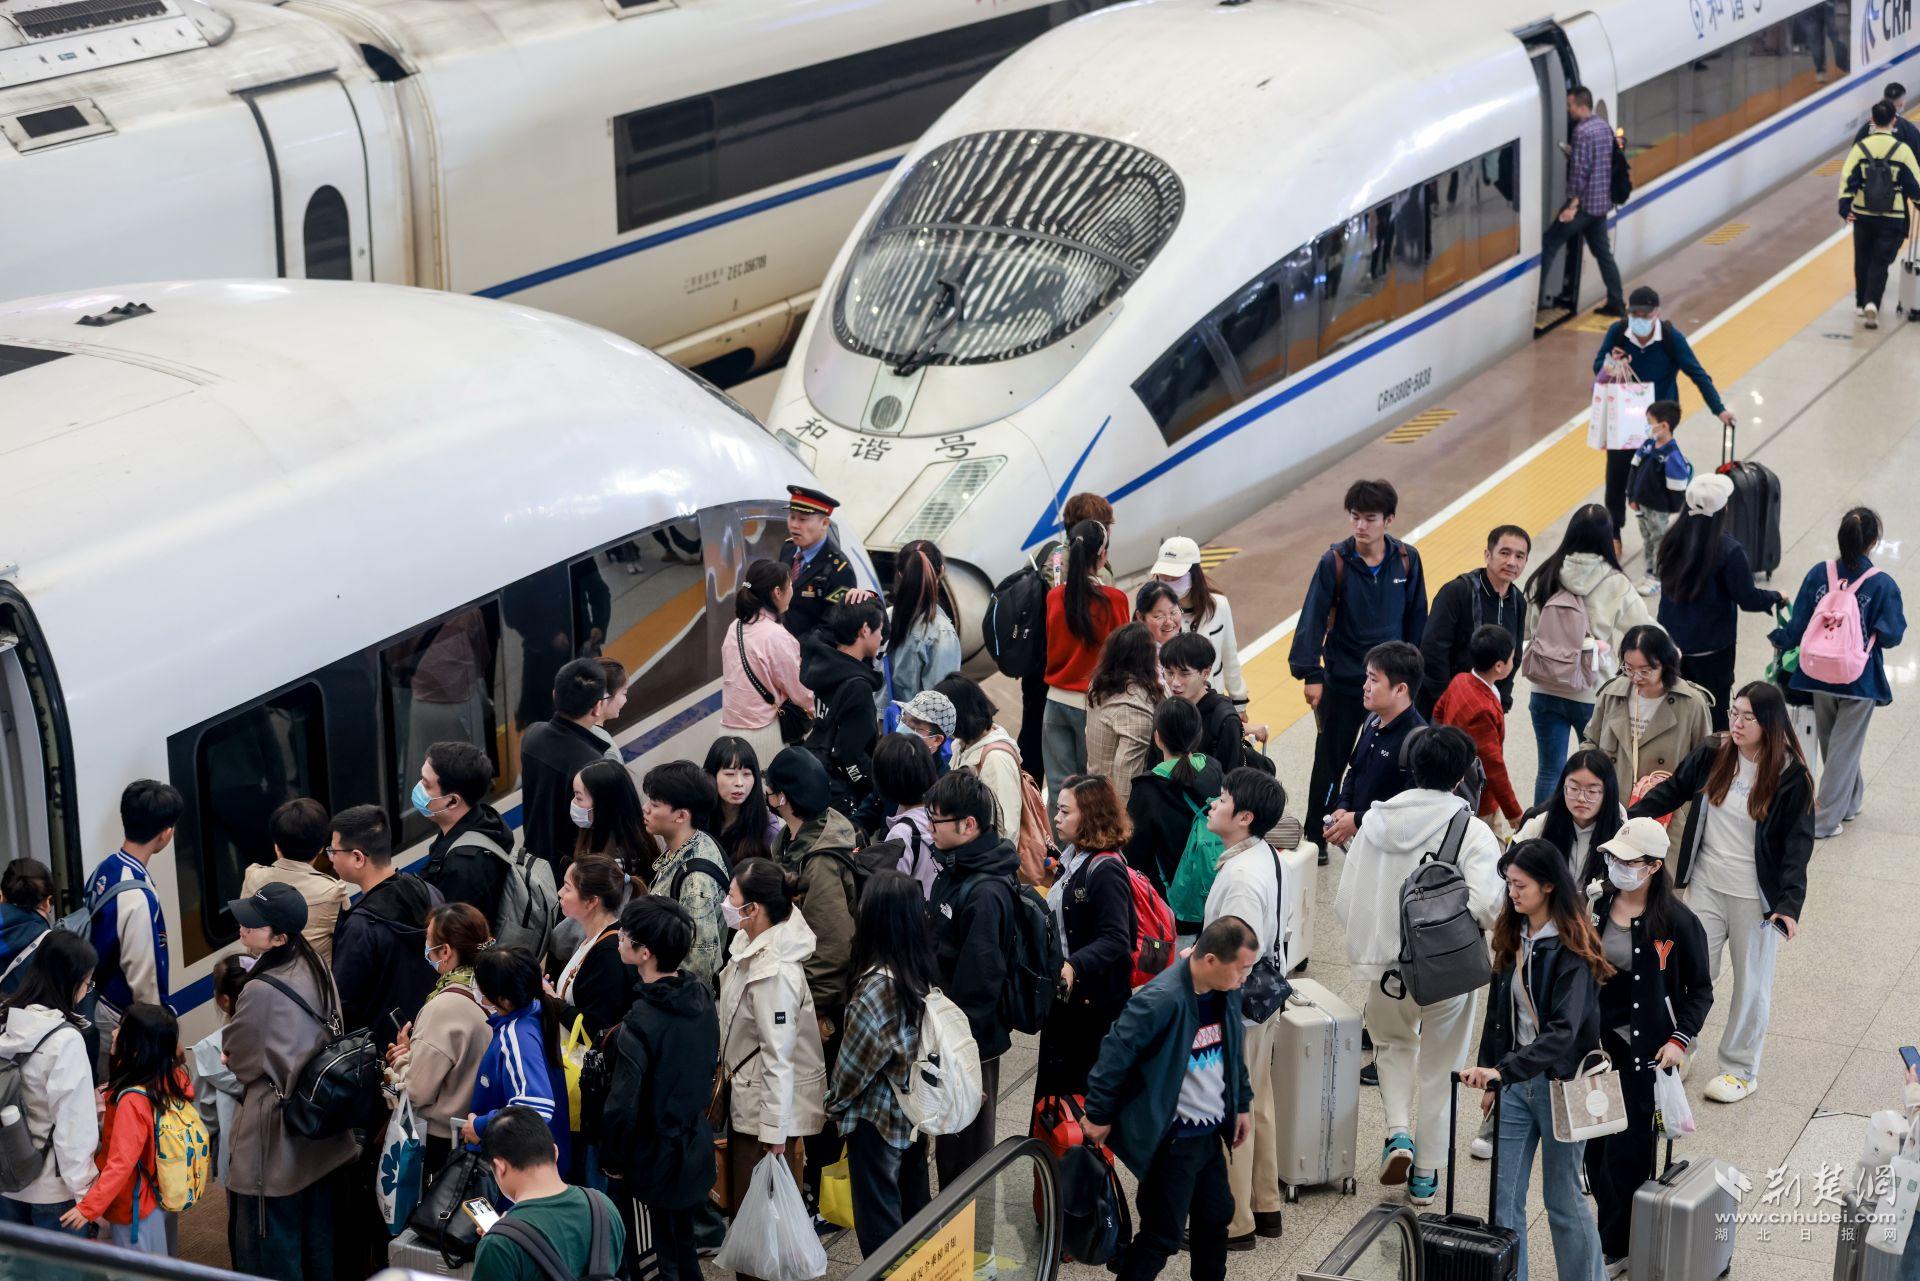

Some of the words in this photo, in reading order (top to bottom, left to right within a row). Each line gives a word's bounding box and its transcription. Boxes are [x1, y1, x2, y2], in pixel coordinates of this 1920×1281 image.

[1882, 0, 1912, 41] CRH
[795, 416, 977, 461] 和谐号
[1653, 939, 1675, 971] Y
